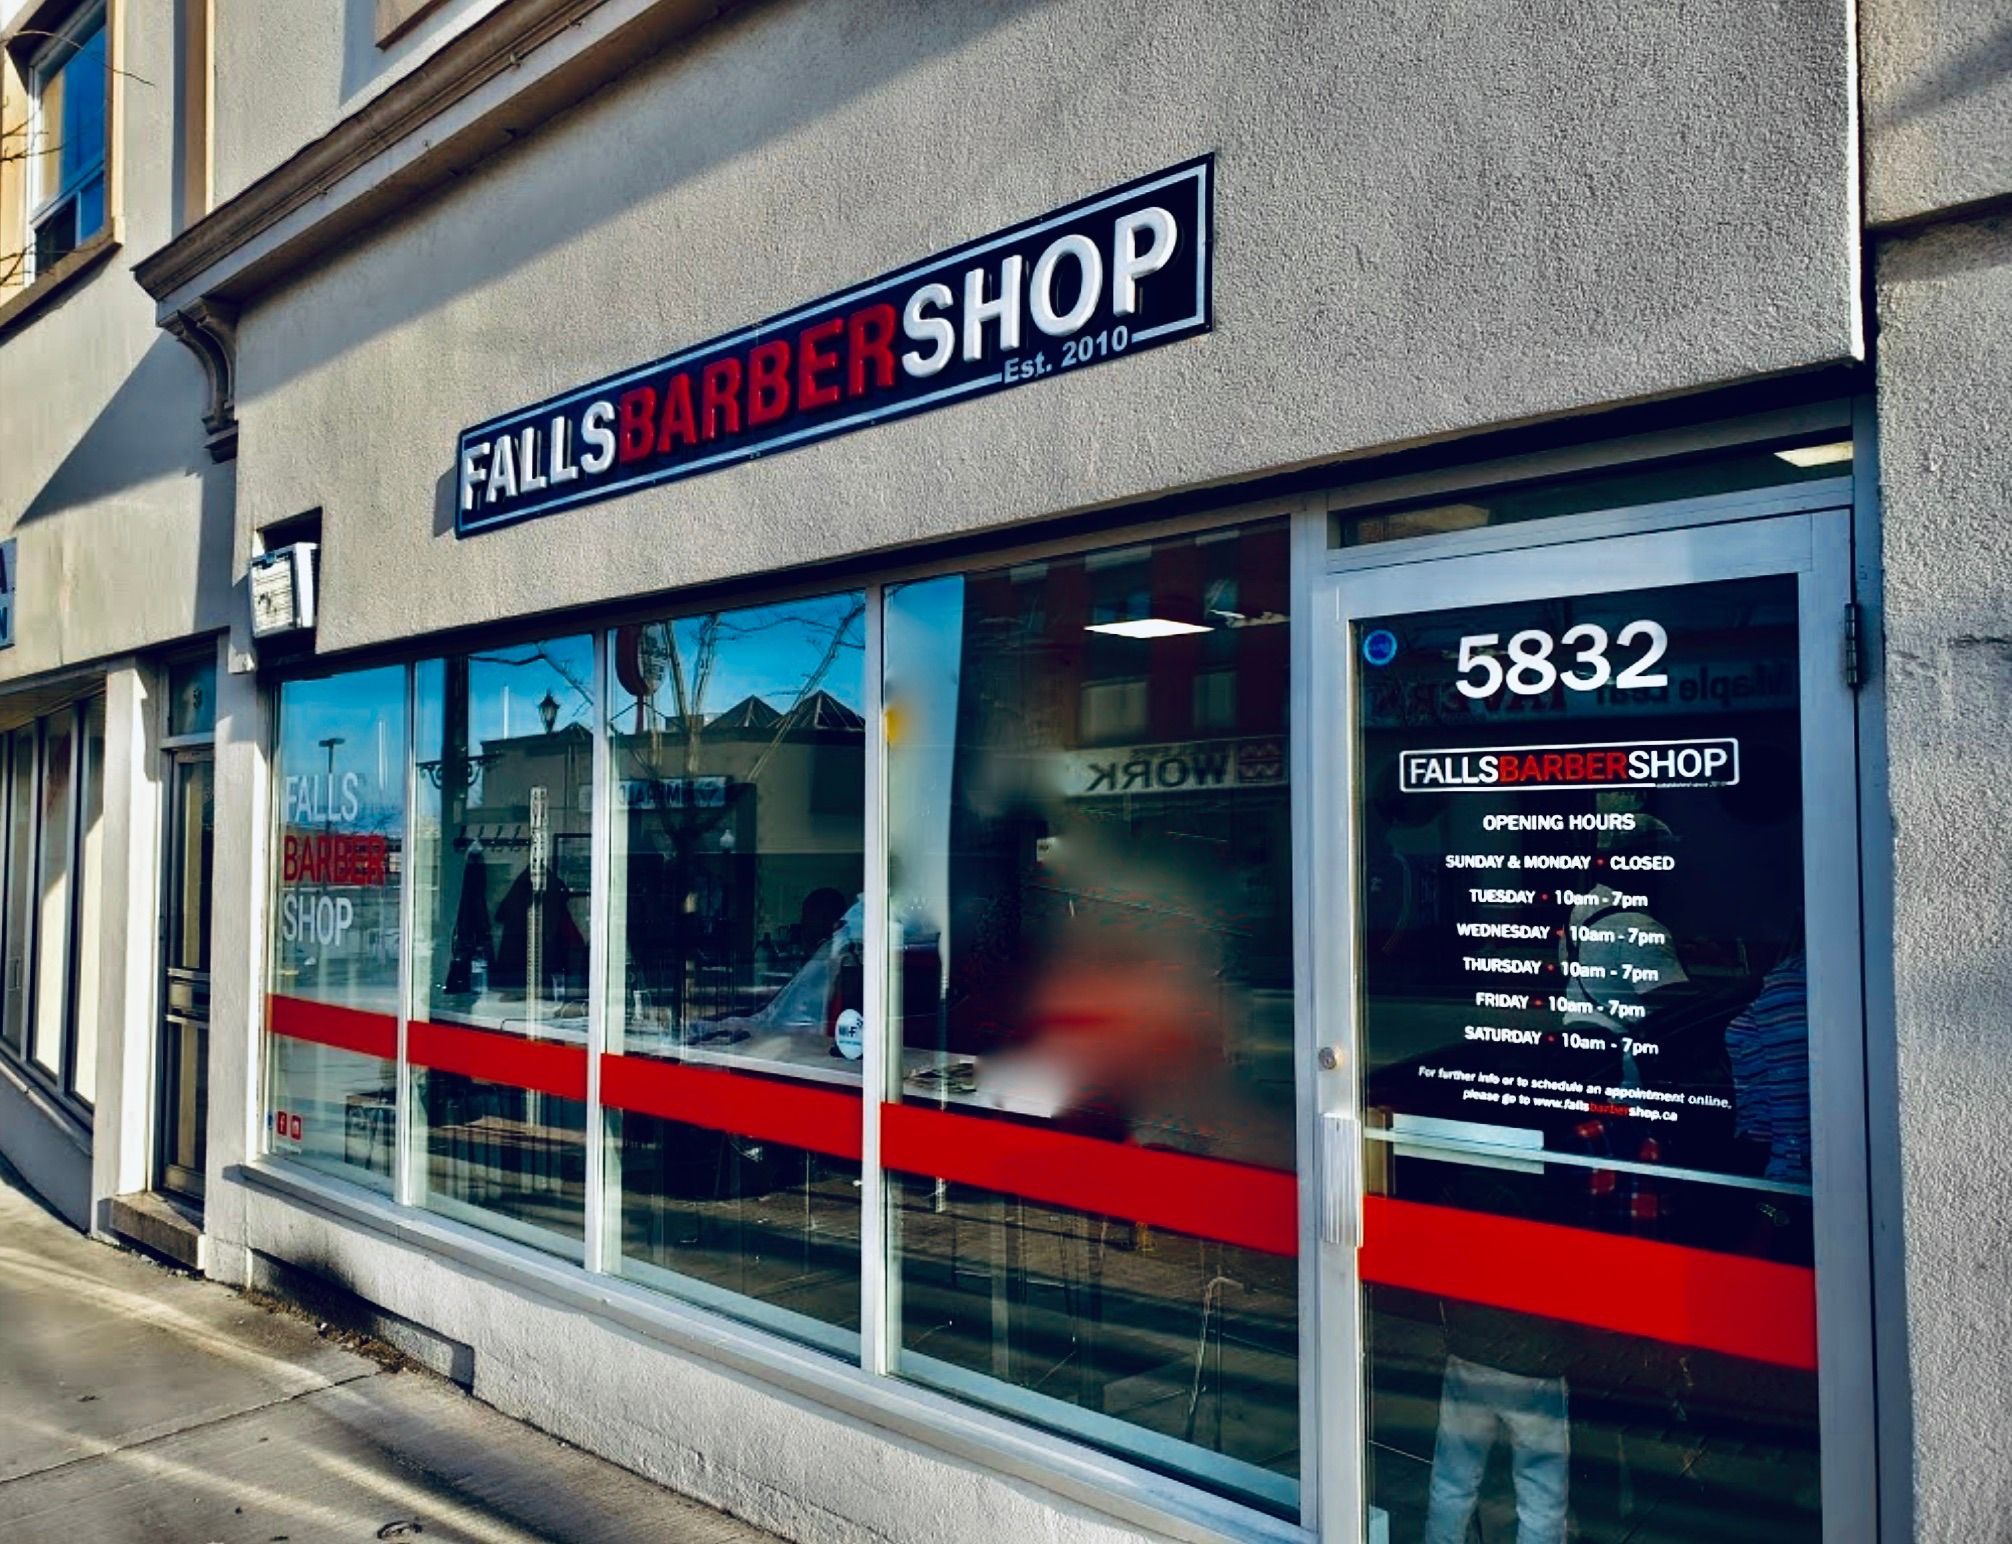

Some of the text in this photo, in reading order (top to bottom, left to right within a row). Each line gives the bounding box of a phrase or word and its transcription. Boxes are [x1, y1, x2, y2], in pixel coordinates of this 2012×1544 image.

[1004, 325, 1128, 384] Est. 2010
[1455, 619, 1668, 699] 5832
[285, 772, 358, 822] FALLS
[1483, 813, 1636, 831] OPENING HOURS
[283, 834, 386, 886] BARBER
[1445, 855, 1675, 871] SUNDAY & MONDAY CLOSED
[1469, 888, 1536, 904] TUESDAY
[1555, 890, 1600, 906] 10am
[1612, 891, 1649, 908] 7pm
[282, 893, 353, 947] SHOP
[1456, 923, 1550, 940] WEDNESDAY
[1570, 926, 1615, 943] 10am
[1628, 928, 1666, 946] 7pm
[1463, 957, 1542, 975] THURSDAY
[1561, 961, 1606, 978] 10am
[1621, 964, 1659, 983] 7pm
[1475, 992, 1529, 1010] FRIDAY
[1549, 996, 1593, 1014] 10am
[1608, 1000, 1646, 1018] 7pm
[1464, 1026, 1542, 1045] SATURDAY
[1562, 1032, 1606, 1051] 10am
[1622, 1038, 1659, 1056] 7pm
[1418, 1065, 1732, 1110] For further info or to schedule an appointment online.
[1463, 1088, 1500, 1102] please
[1501, 1093, 1517, 1105] go
[1518, 1094, 1531, 1105] to
